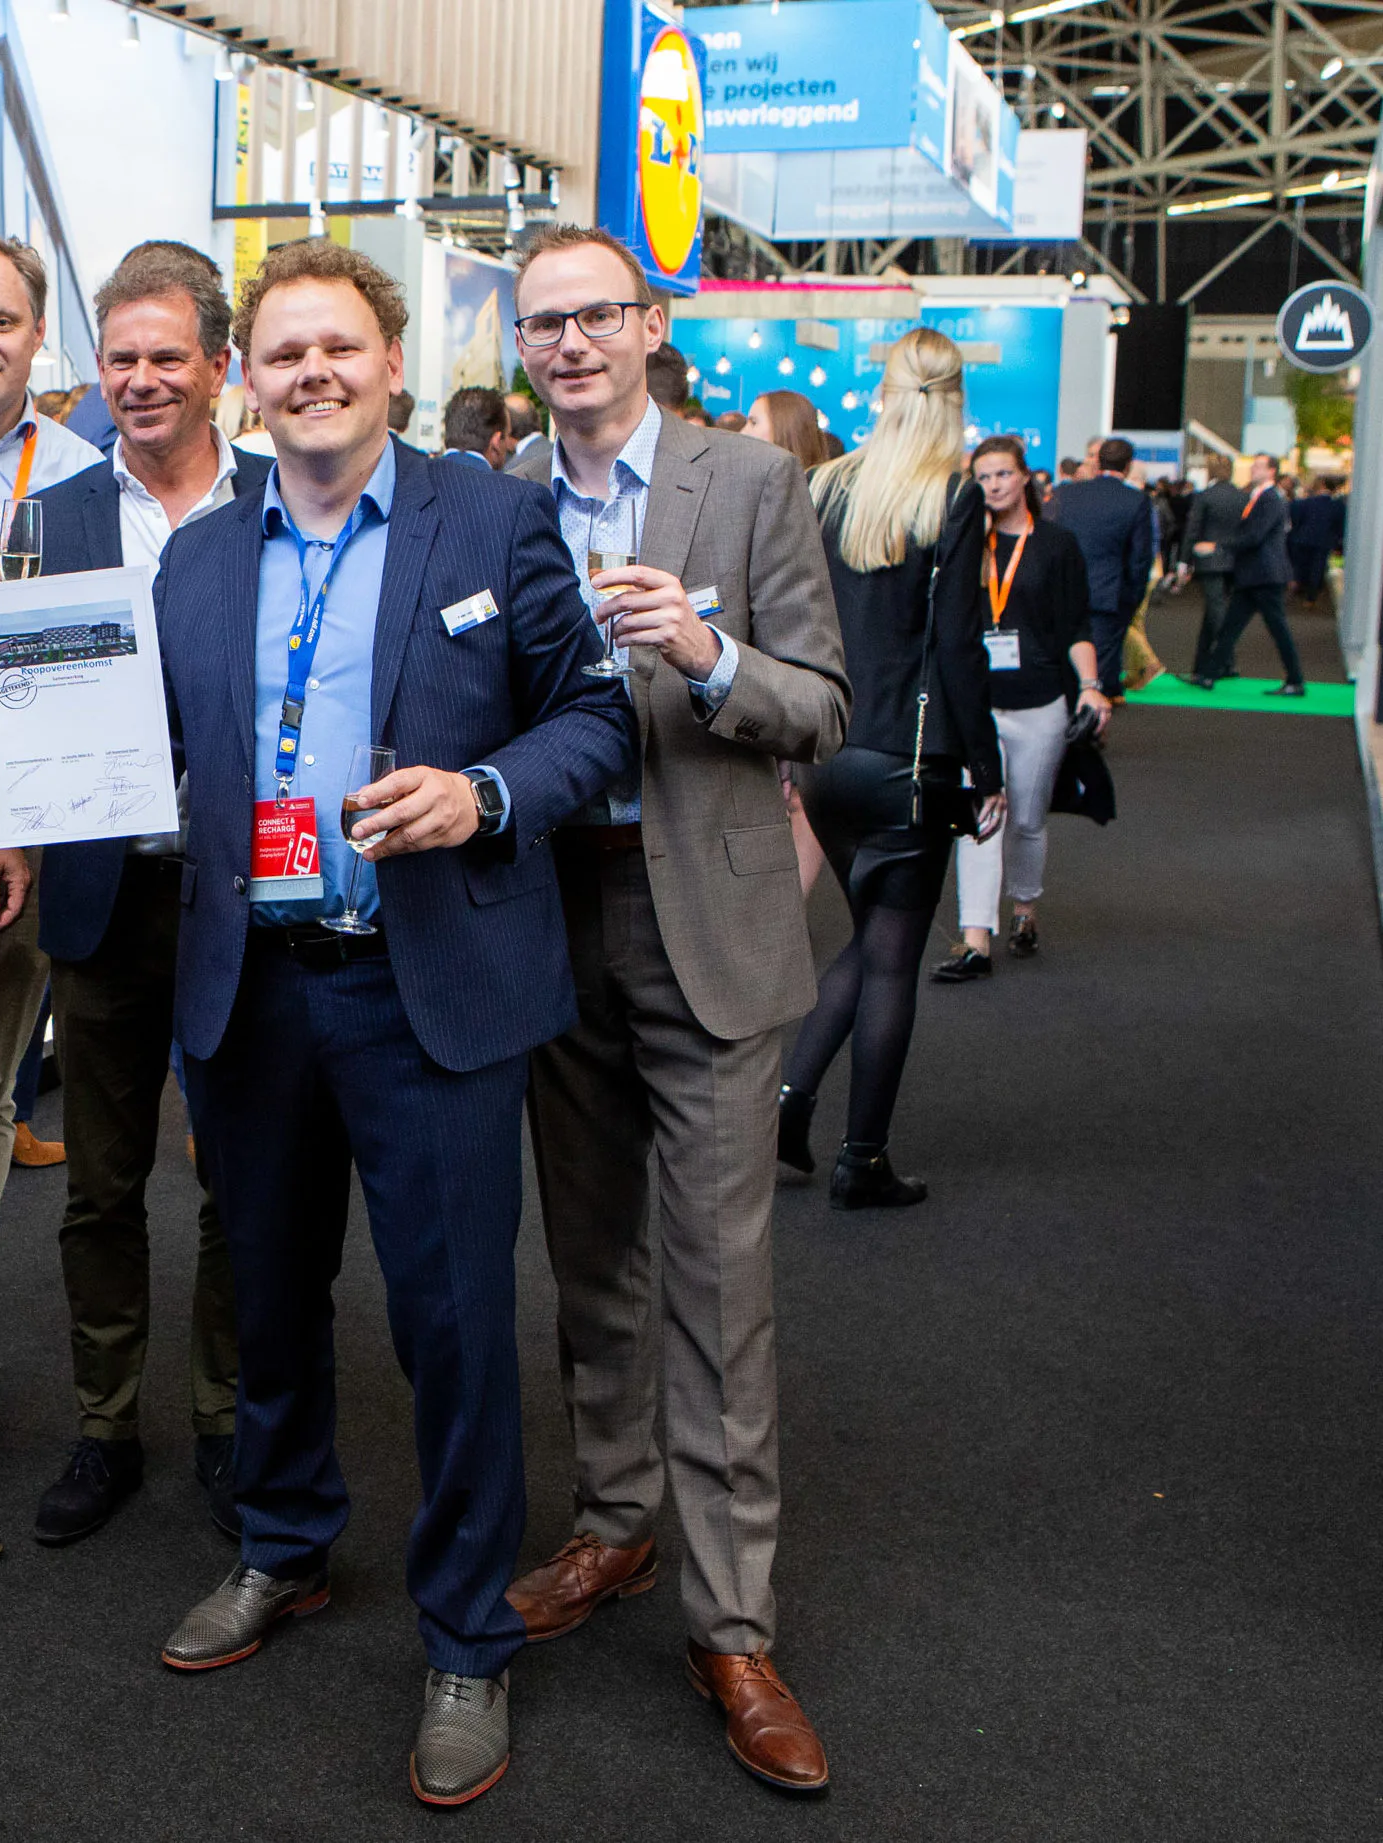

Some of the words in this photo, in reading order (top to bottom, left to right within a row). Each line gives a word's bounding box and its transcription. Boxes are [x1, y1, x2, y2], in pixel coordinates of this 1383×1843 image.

[745, 52, 778, 74] wij
[724, 78, 837, 102] projecten
[21, 658, 113, 674] Koopovereenkomst
[258, 817, 289, 827] CONNECT
[258, 824, 296, 834] RECHARGE
